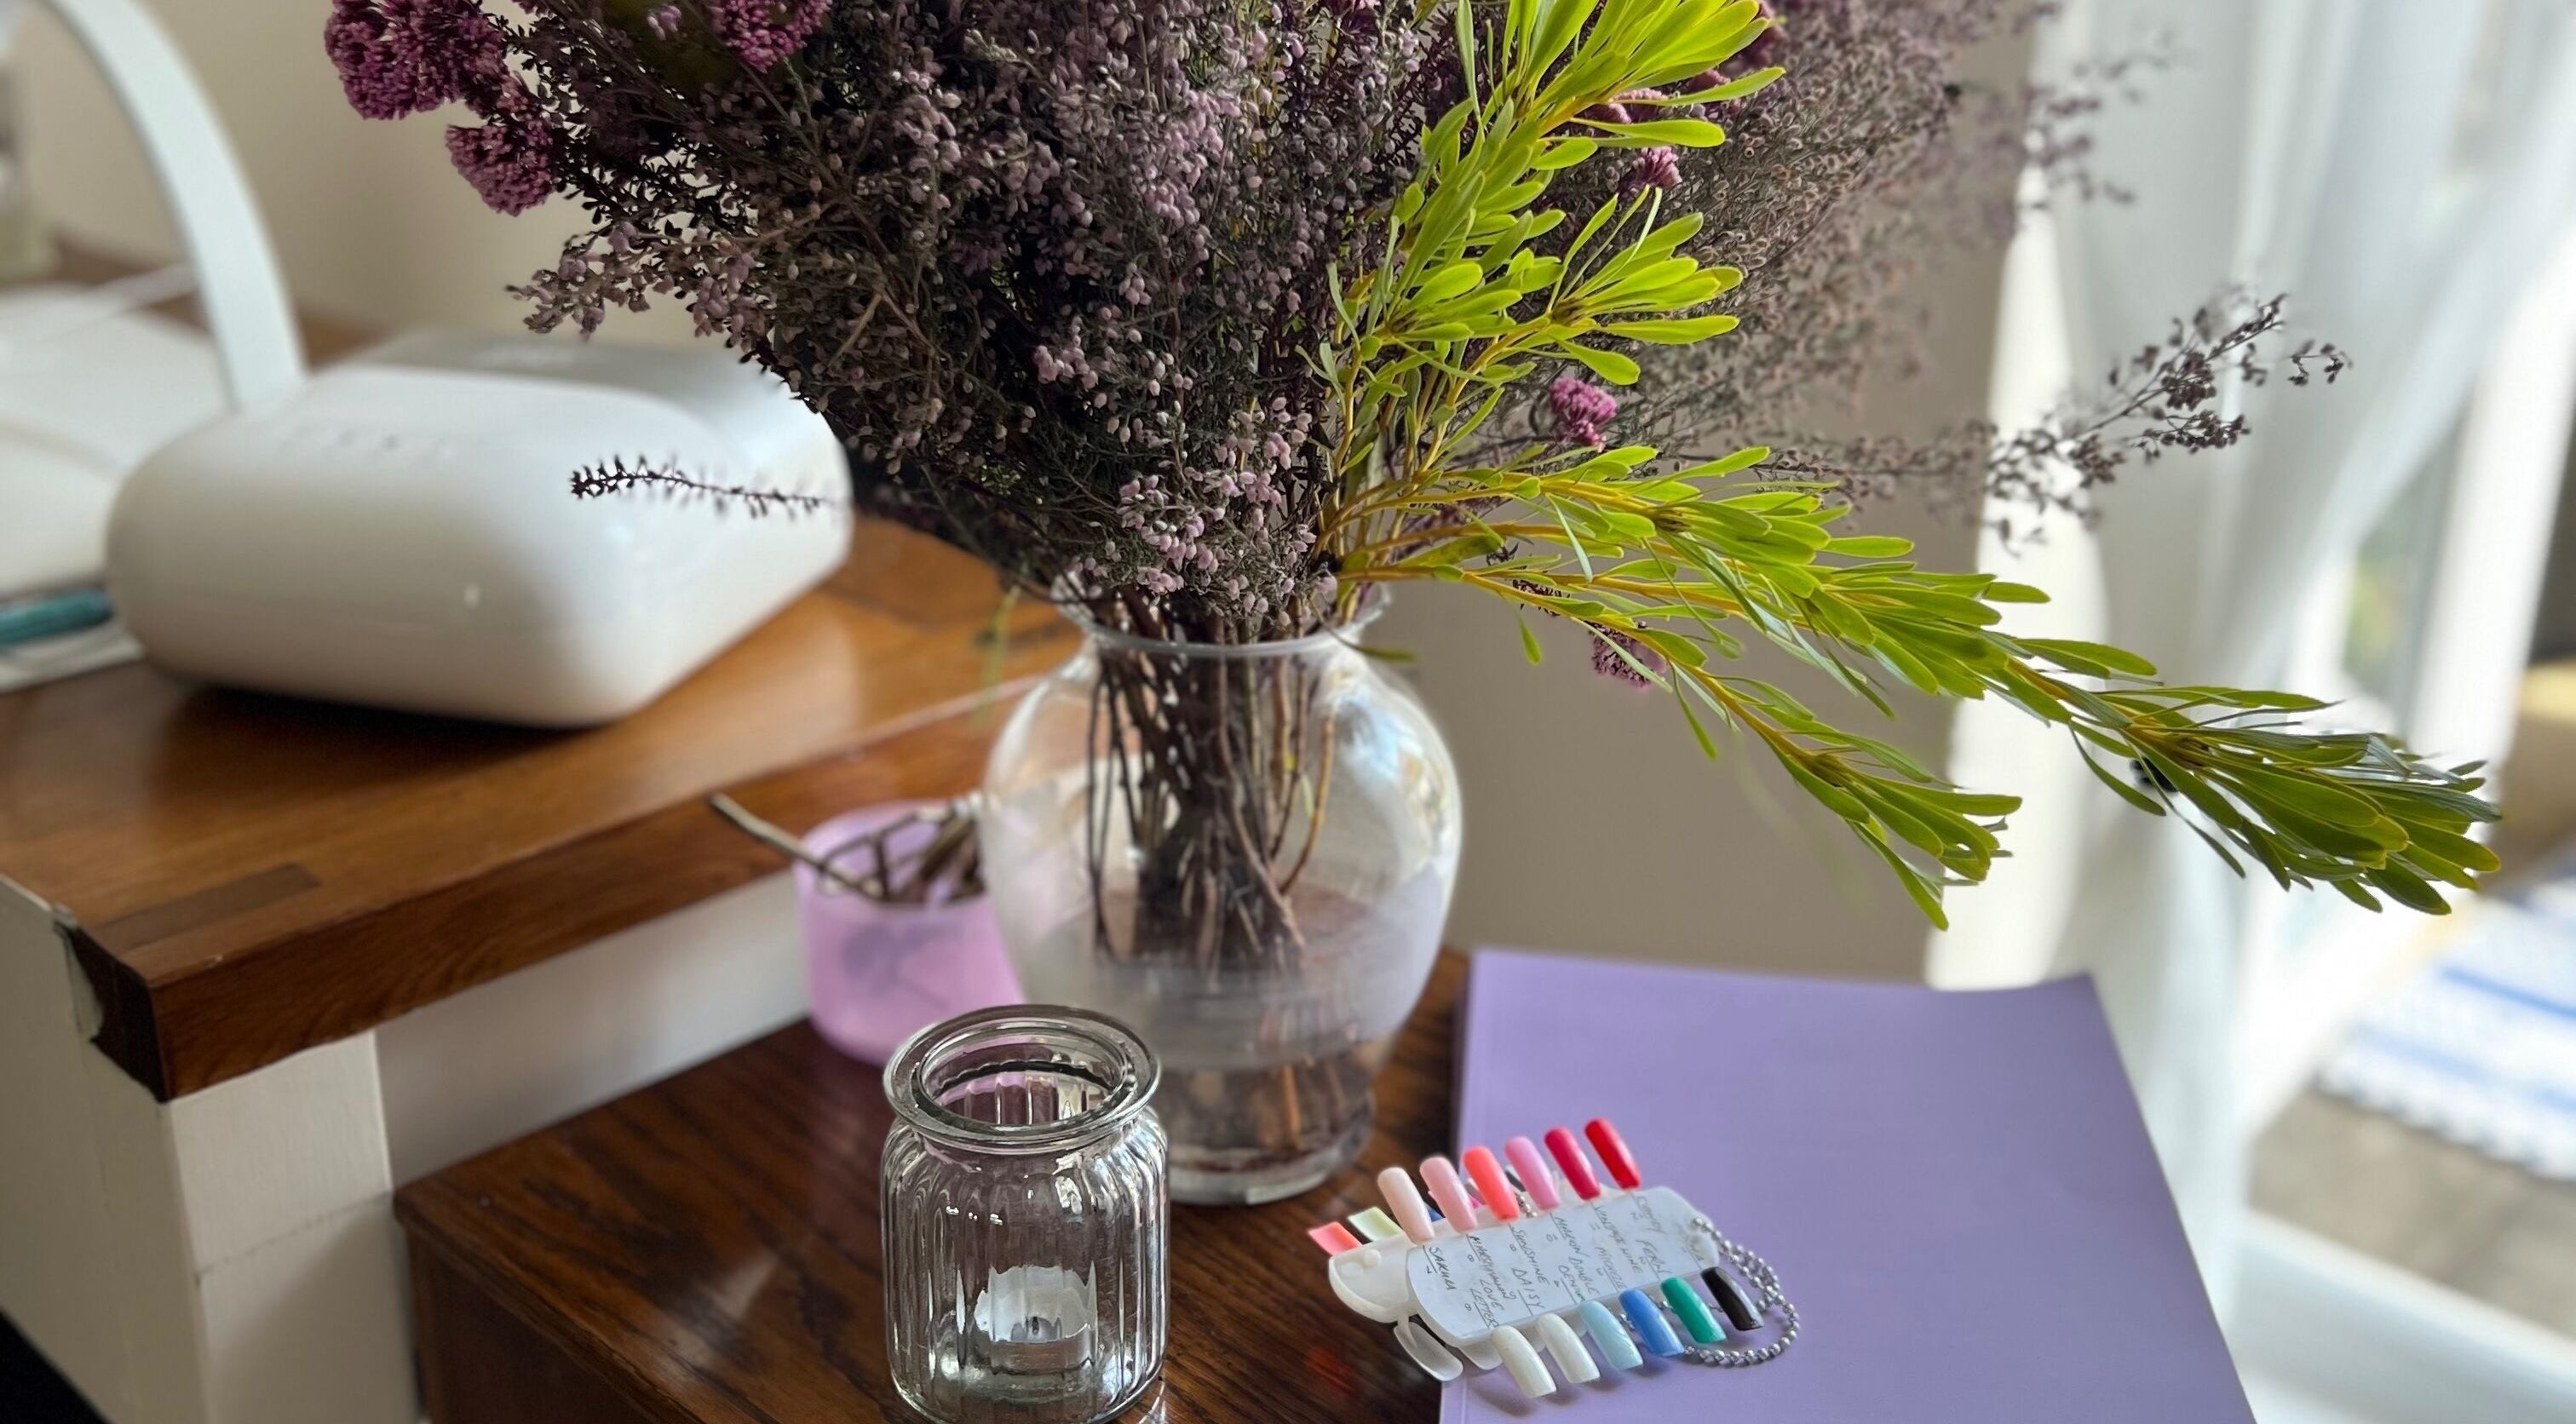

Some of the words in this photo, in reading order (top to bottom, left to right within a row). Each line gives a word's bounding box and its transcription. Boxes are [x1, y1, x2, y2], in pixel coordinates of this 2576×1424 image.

[1511, 1226, 1550, 1285] SUNSHINE
[1568, 1256, 1601, 1295] DOUBLE
[1479, 1279, 1505, 1311] LOVE
[1511, 1267, 1545, 1309] DAISY
